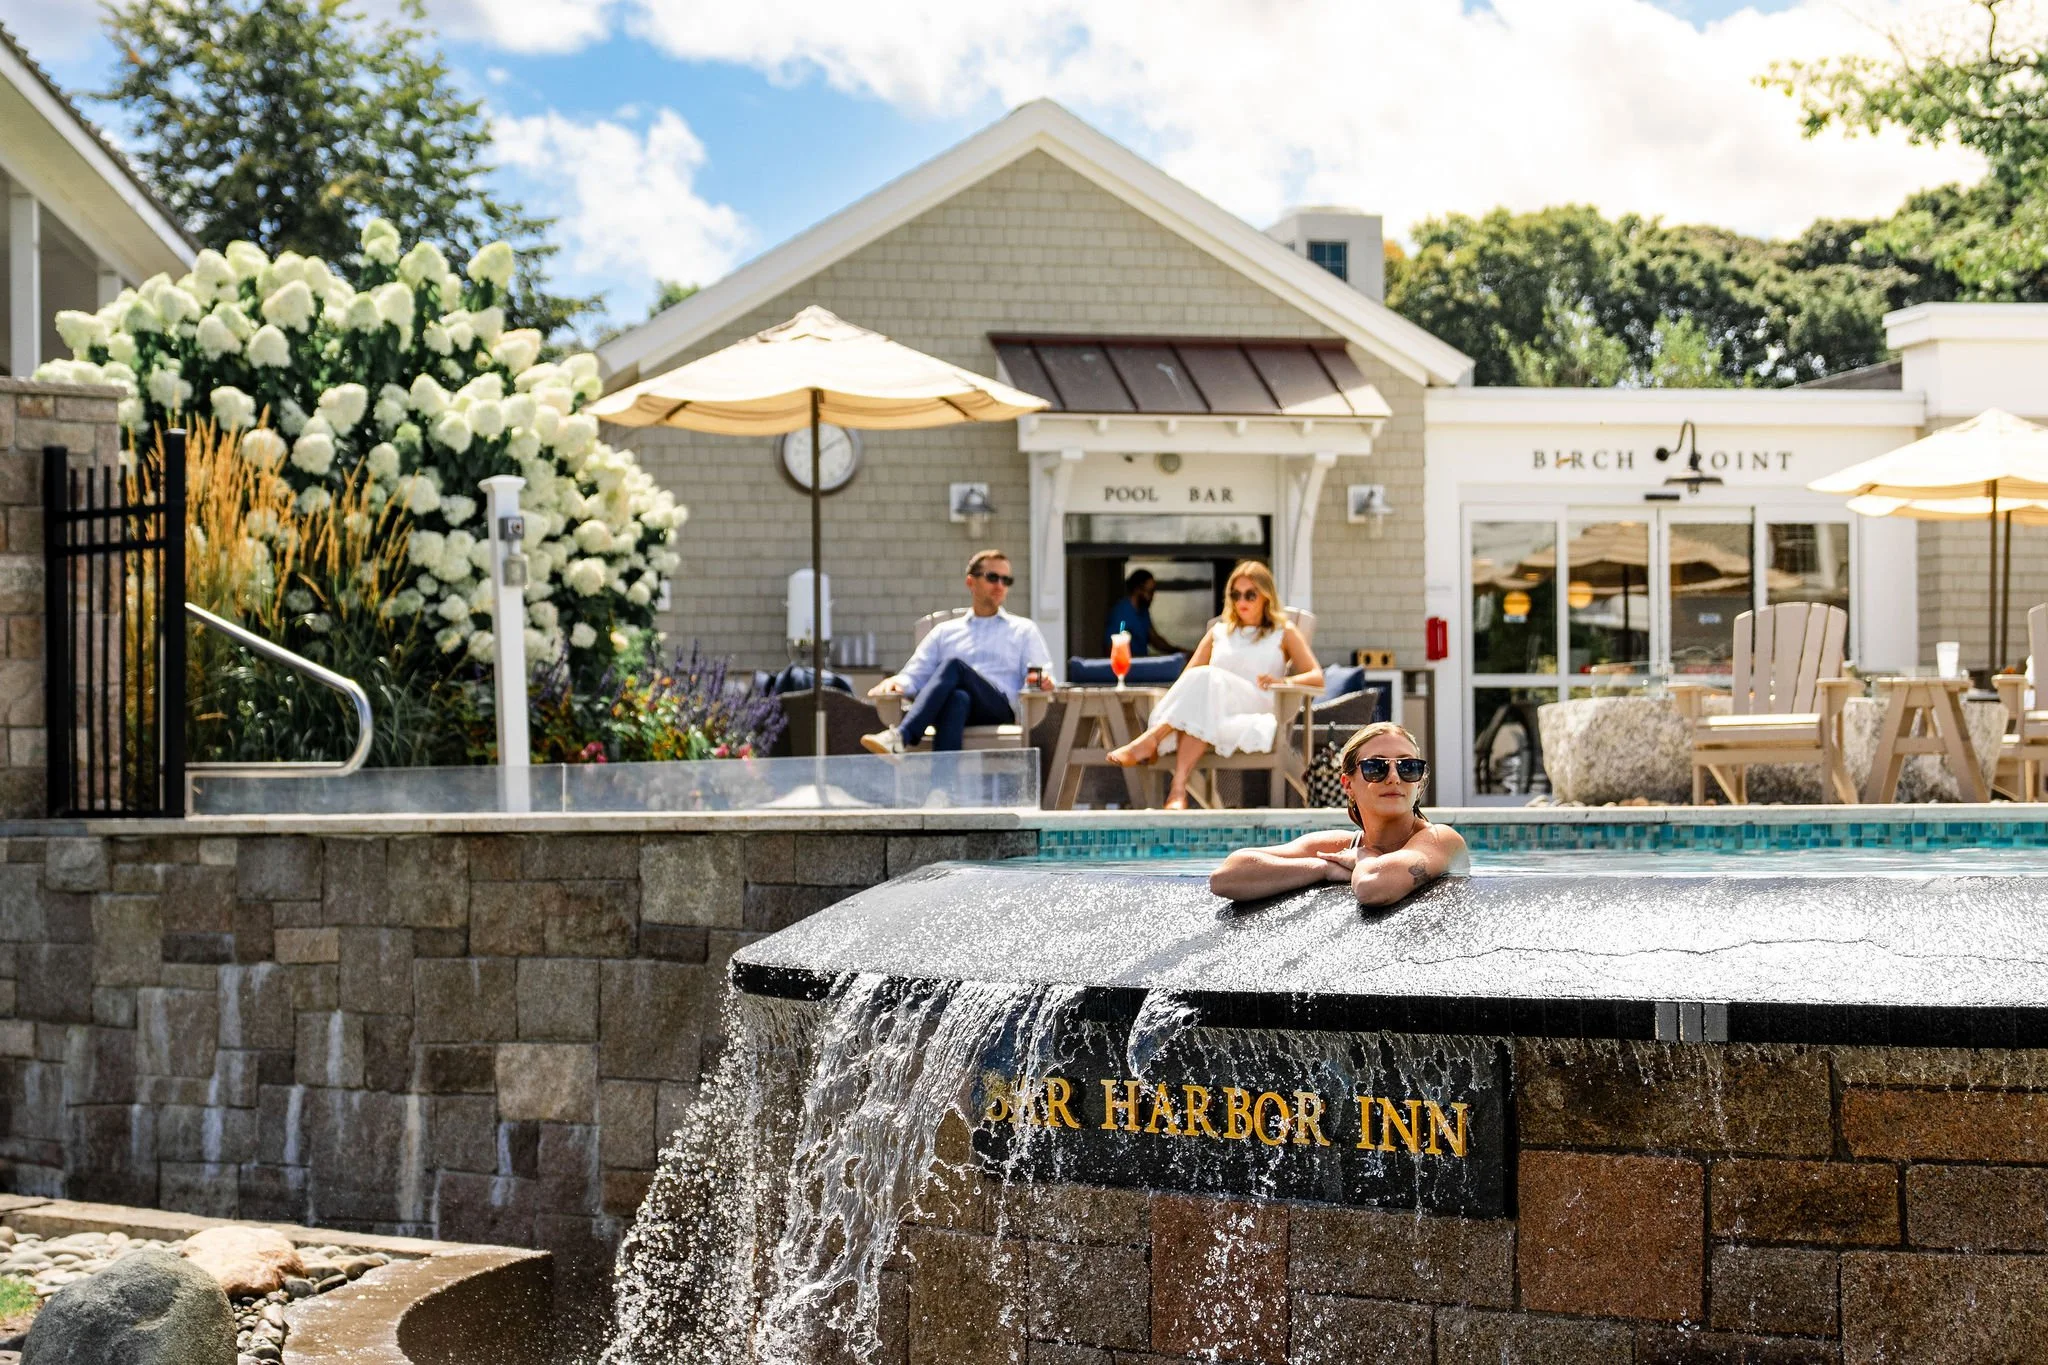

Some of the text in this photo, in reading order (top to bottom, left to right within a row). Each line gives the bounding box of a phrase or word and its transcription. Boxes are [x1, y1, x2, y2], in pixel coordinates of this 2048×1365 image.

[1533, 450, 1633, 469] BIRCH
[1104, 486, 1233, 502] POOL BAR
[1101, 1079, 1331, 1147] HARBOR
[1356, 1096, 1470, 1157] INN
